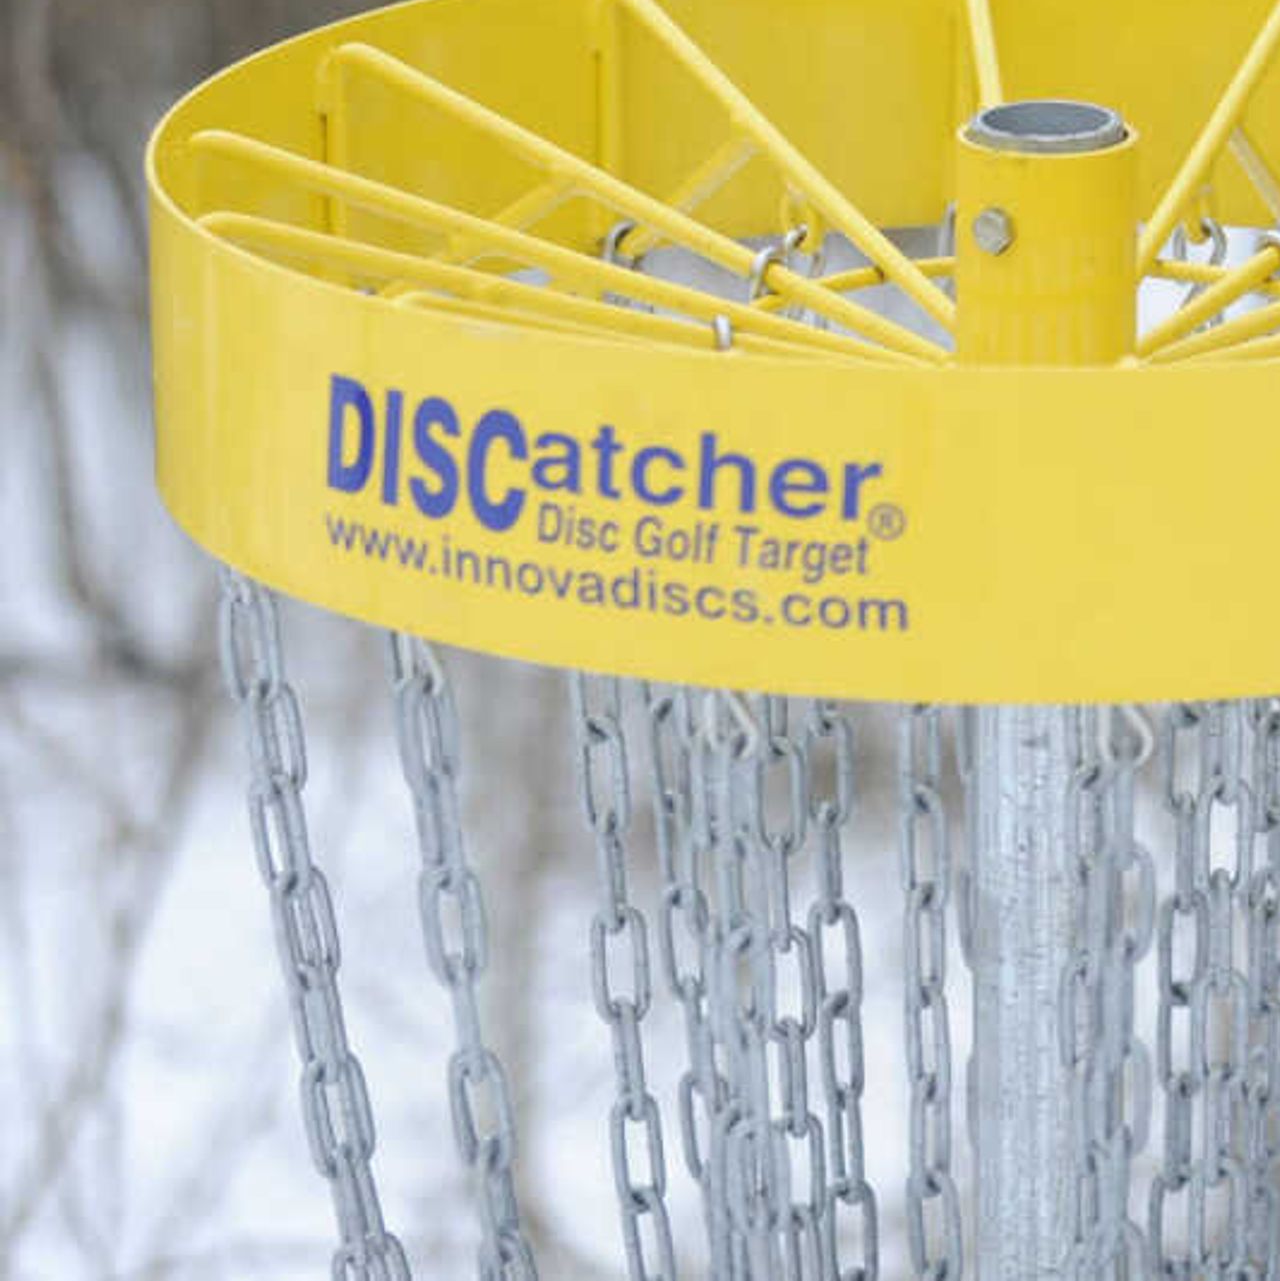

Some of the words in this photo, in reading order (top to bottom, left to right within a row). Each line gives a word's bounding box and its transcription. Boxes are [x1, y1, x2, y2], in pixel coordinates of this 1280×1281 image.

[324, 512, 909, 632] www.innovadiscs.com
[537, 502, 620, 553] Disc
[632, 515, 718, 563] Golf
[734, 525, 869, 583] Target
